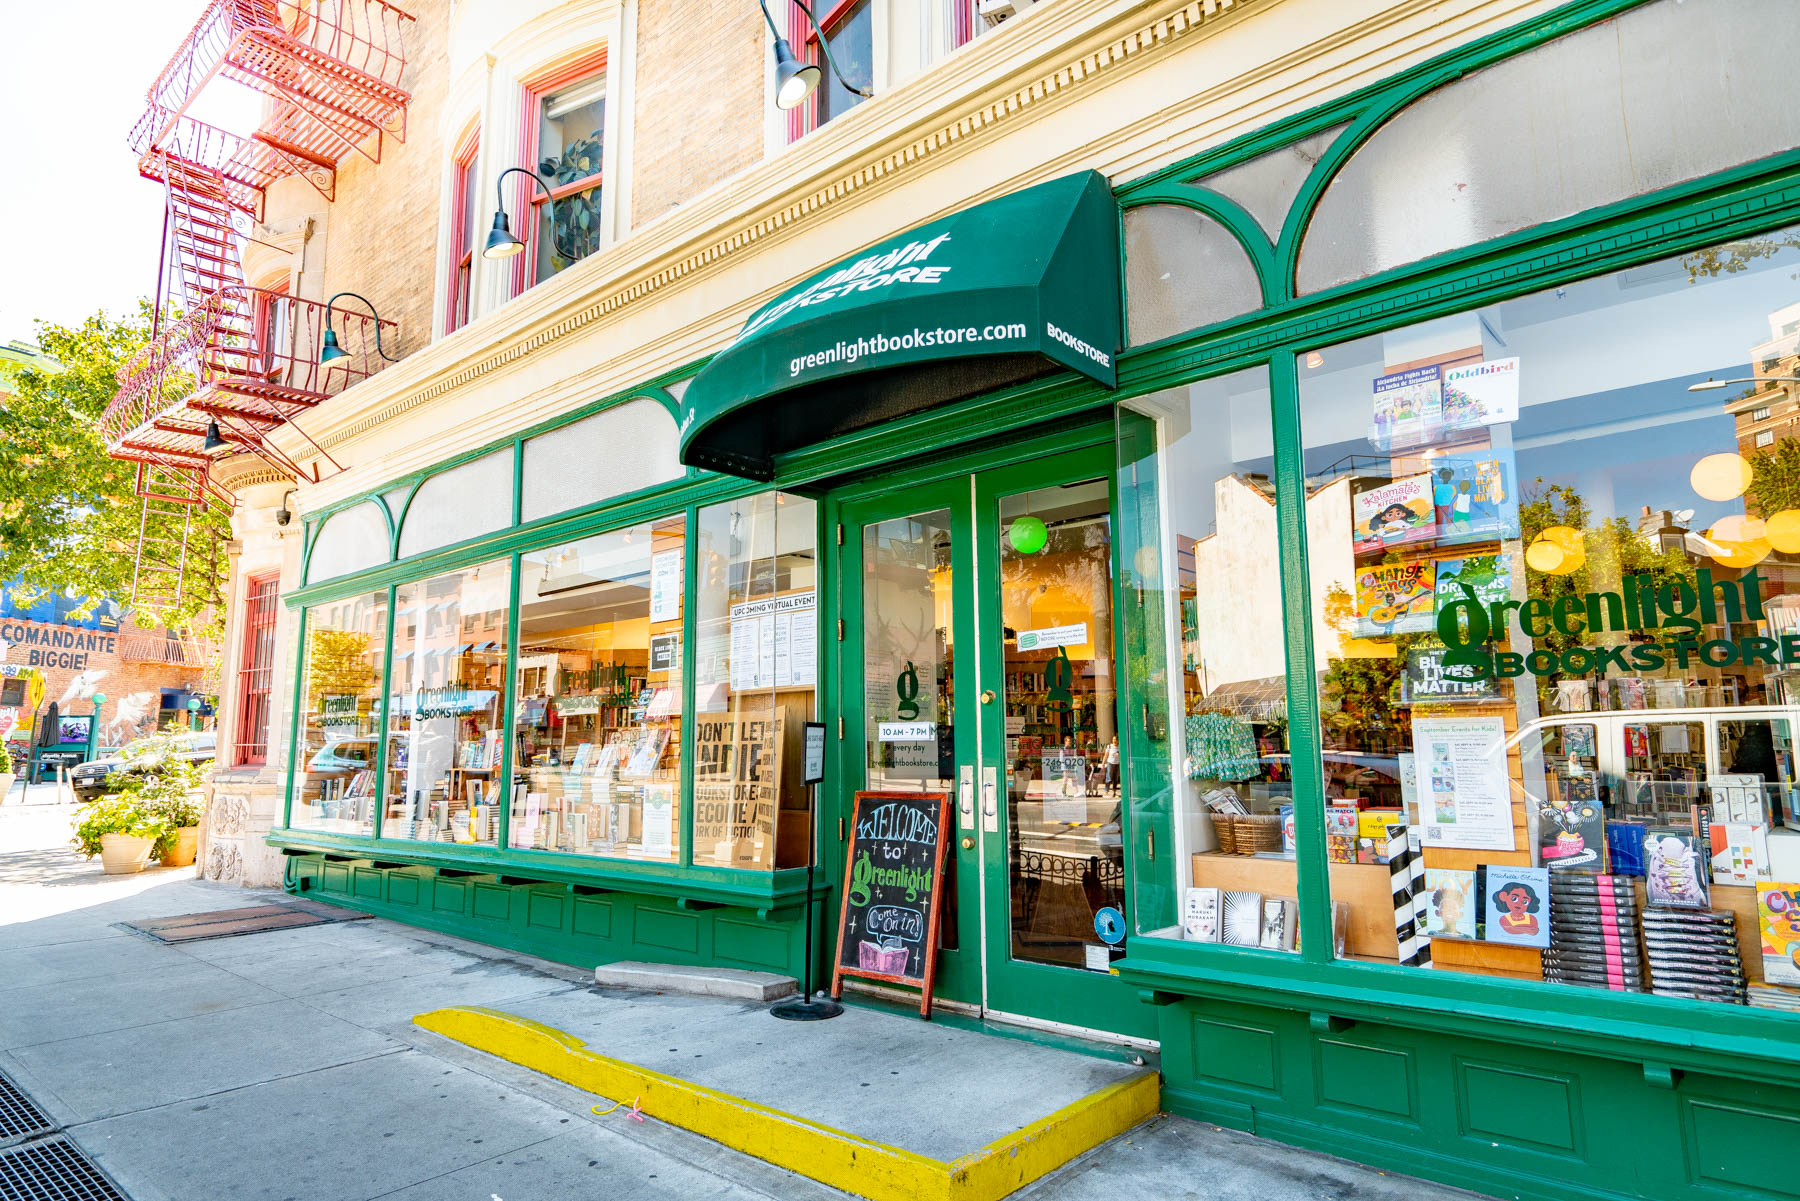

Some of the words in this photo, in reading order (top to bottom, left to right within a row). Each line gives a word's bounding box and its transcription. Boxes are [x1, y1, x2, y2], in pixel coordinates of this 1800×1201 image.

[790, 323, 1027, 377] greenlightbookstore.com
[1047, 322, 1110, 368] BOOKSTORE
[1449, 361, 1514, 380] Oddbird
[1362, 481, 1420, 507] Kalamata's
[1377, 495, 1408, 508] KITCHEN
[1474, 491, 1505, 502] MATR
[734, 604, 766, 616] UPCOMING
[1437, 565, 1769, 683] greenlight
[1, 624, 116, 653] COMANDANTE
[29, 649, 88, 671] BIGGIE!
[1495, 635, 1800, 678] BOOKSTORE
[1413, 680, 1485, 694] MATTER
[416, 679, 468, 721] greenlight
[424, 706, 474, 720] BOOKSTORE
[697, 722, 736, 742] DON'T
[883, 728, 891, 736] 10
[893, 728, 904, 736] AM
[910, 728, 915, 736] 7
[916, 728, 927, 736] PM
[892, 744, 911, 753] every
[913, 741, 925, 753] day
[697, 744, 763, 782] NDIE
[872, 757, 939, 768] greenlightbookstore.c
[696, 785, 760, 801] OOKSORE
[696, 803, 748, 824] ECOME
[726, 825, 756, 839] FCTIO
[857, 803, 937, 845] WELCOME
[882, 842, 901, 860] to
[849, 849, 933, 907] greenlight
[1427, 876, 1473, 895] JOY
[868, 908, 899, 930] Come
[900, 912, 920, 938] in!
